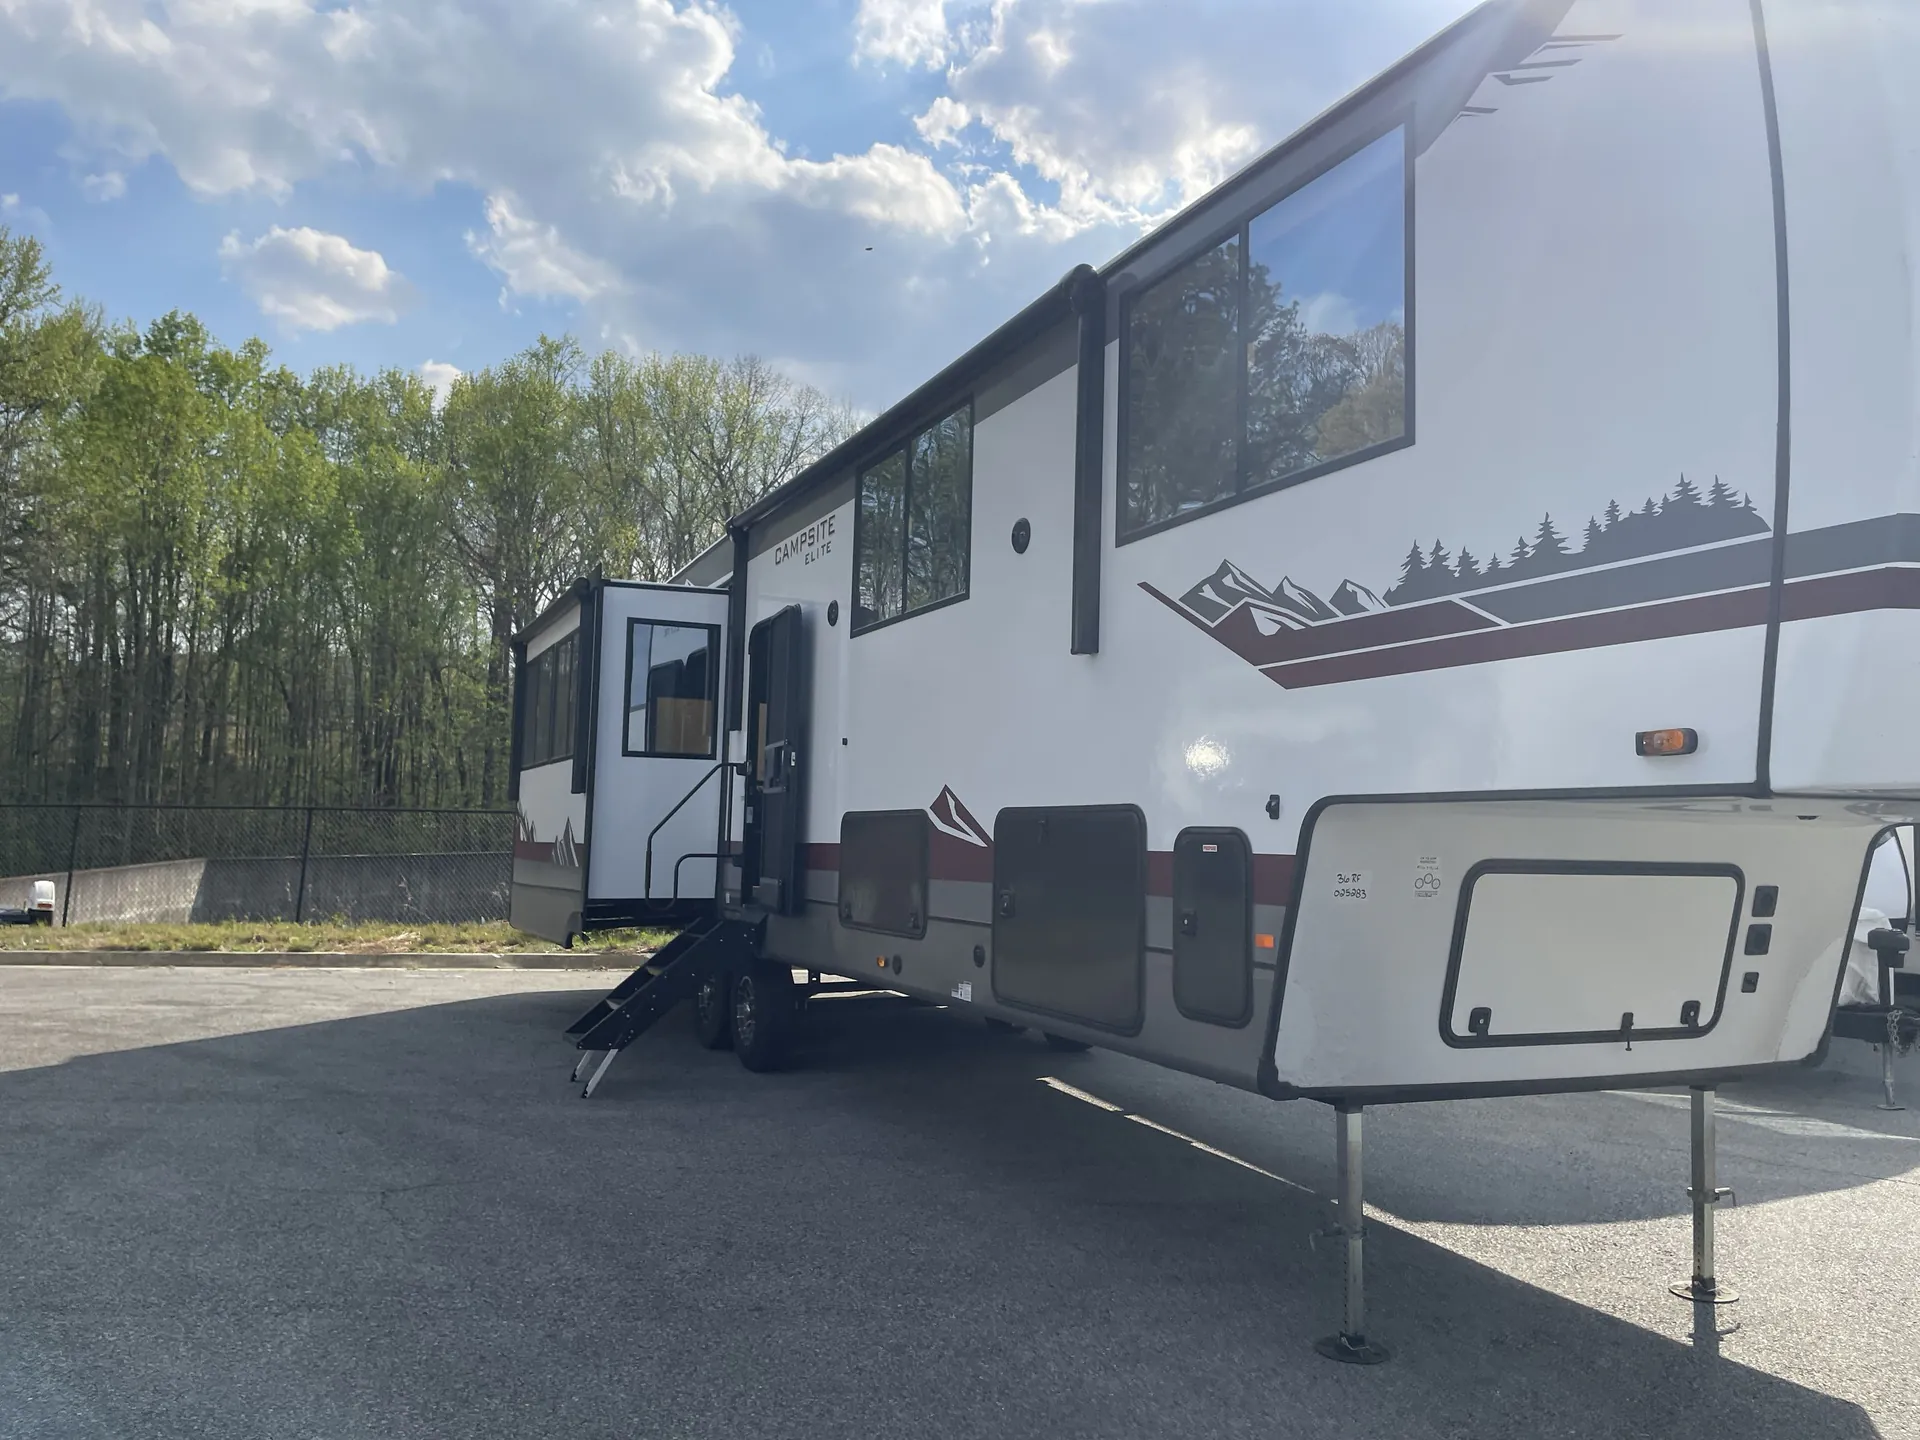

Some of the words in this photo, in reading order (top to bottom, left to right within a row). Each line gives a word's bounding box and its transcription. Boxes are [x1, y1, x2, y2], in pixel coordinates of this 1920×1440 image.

[775, 514, 836, 566] CAMPSITE
[804, 541, 832, 566] ELITE
[1337, 873, 1350, 884] 36
[1333, 888, 1367, 899] 025283
